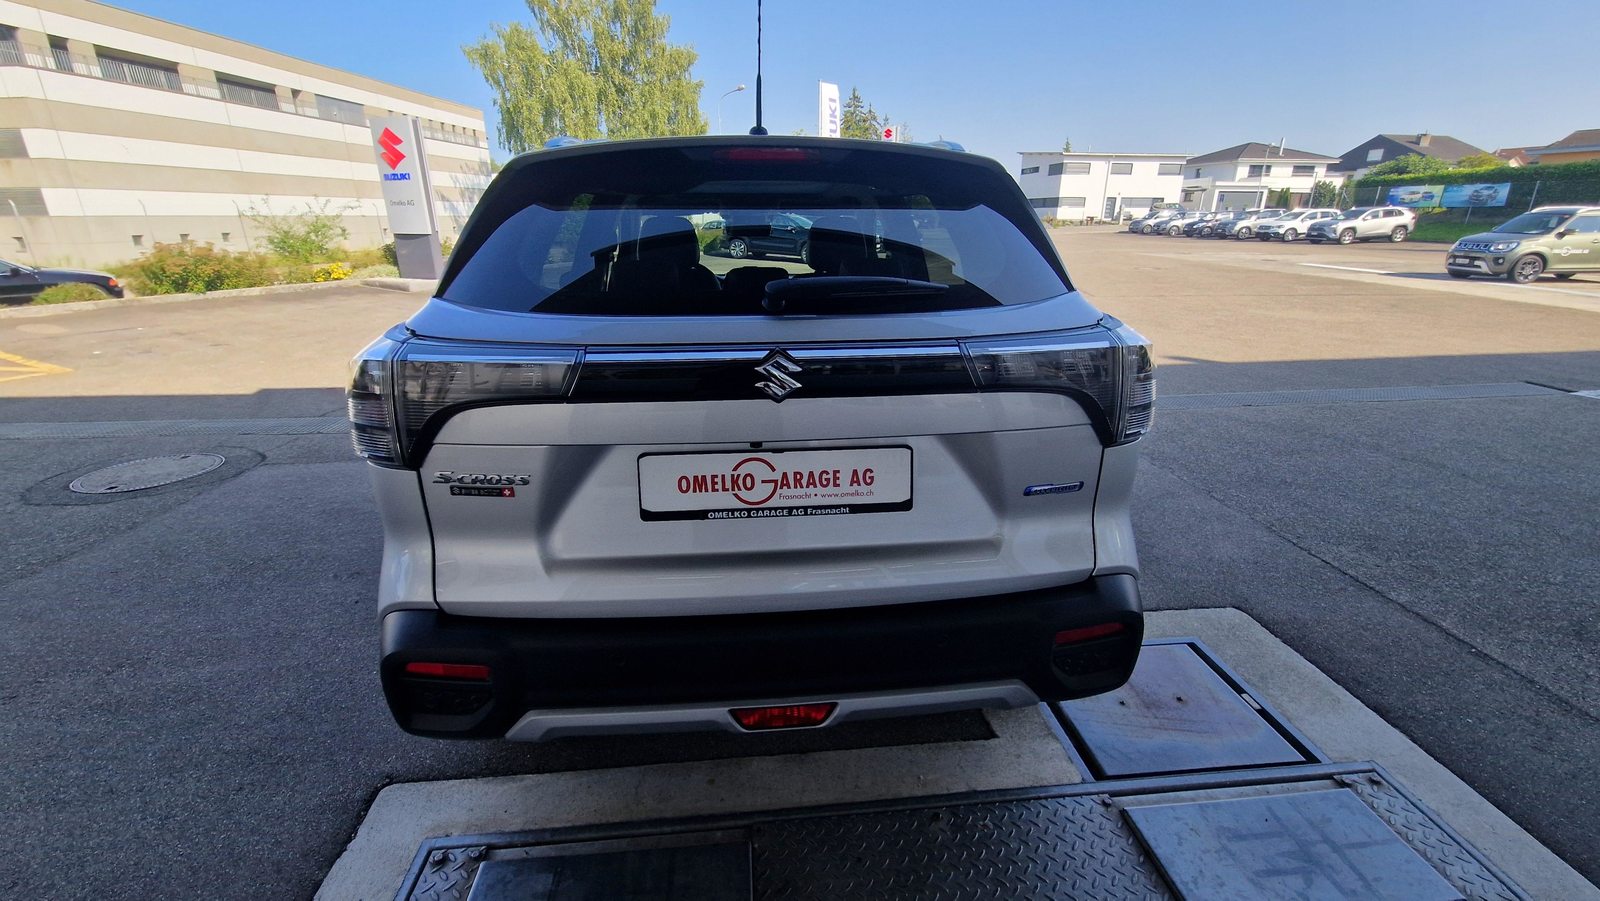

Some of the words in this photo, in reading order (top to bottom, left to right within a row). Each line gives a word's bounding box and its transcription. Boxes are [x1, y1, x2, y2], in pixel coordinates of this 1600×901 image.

[828, 98, 838, 137] UKI
[677, 472, 756, 494] OMELKO
[732, 456, 841, 506] GARAGE
[849, 467, 875, 487] AG
[779, 492, 811, 500] Frasnacht
[820, 489, 874, 499] www.omelko.ch
[707, 510, 748, 519] OMELKO
[750, 509, 789, 518] GARAGE
[791, 508, 805, 516] AG
[807, 506, 850, 515] Frasnacht
